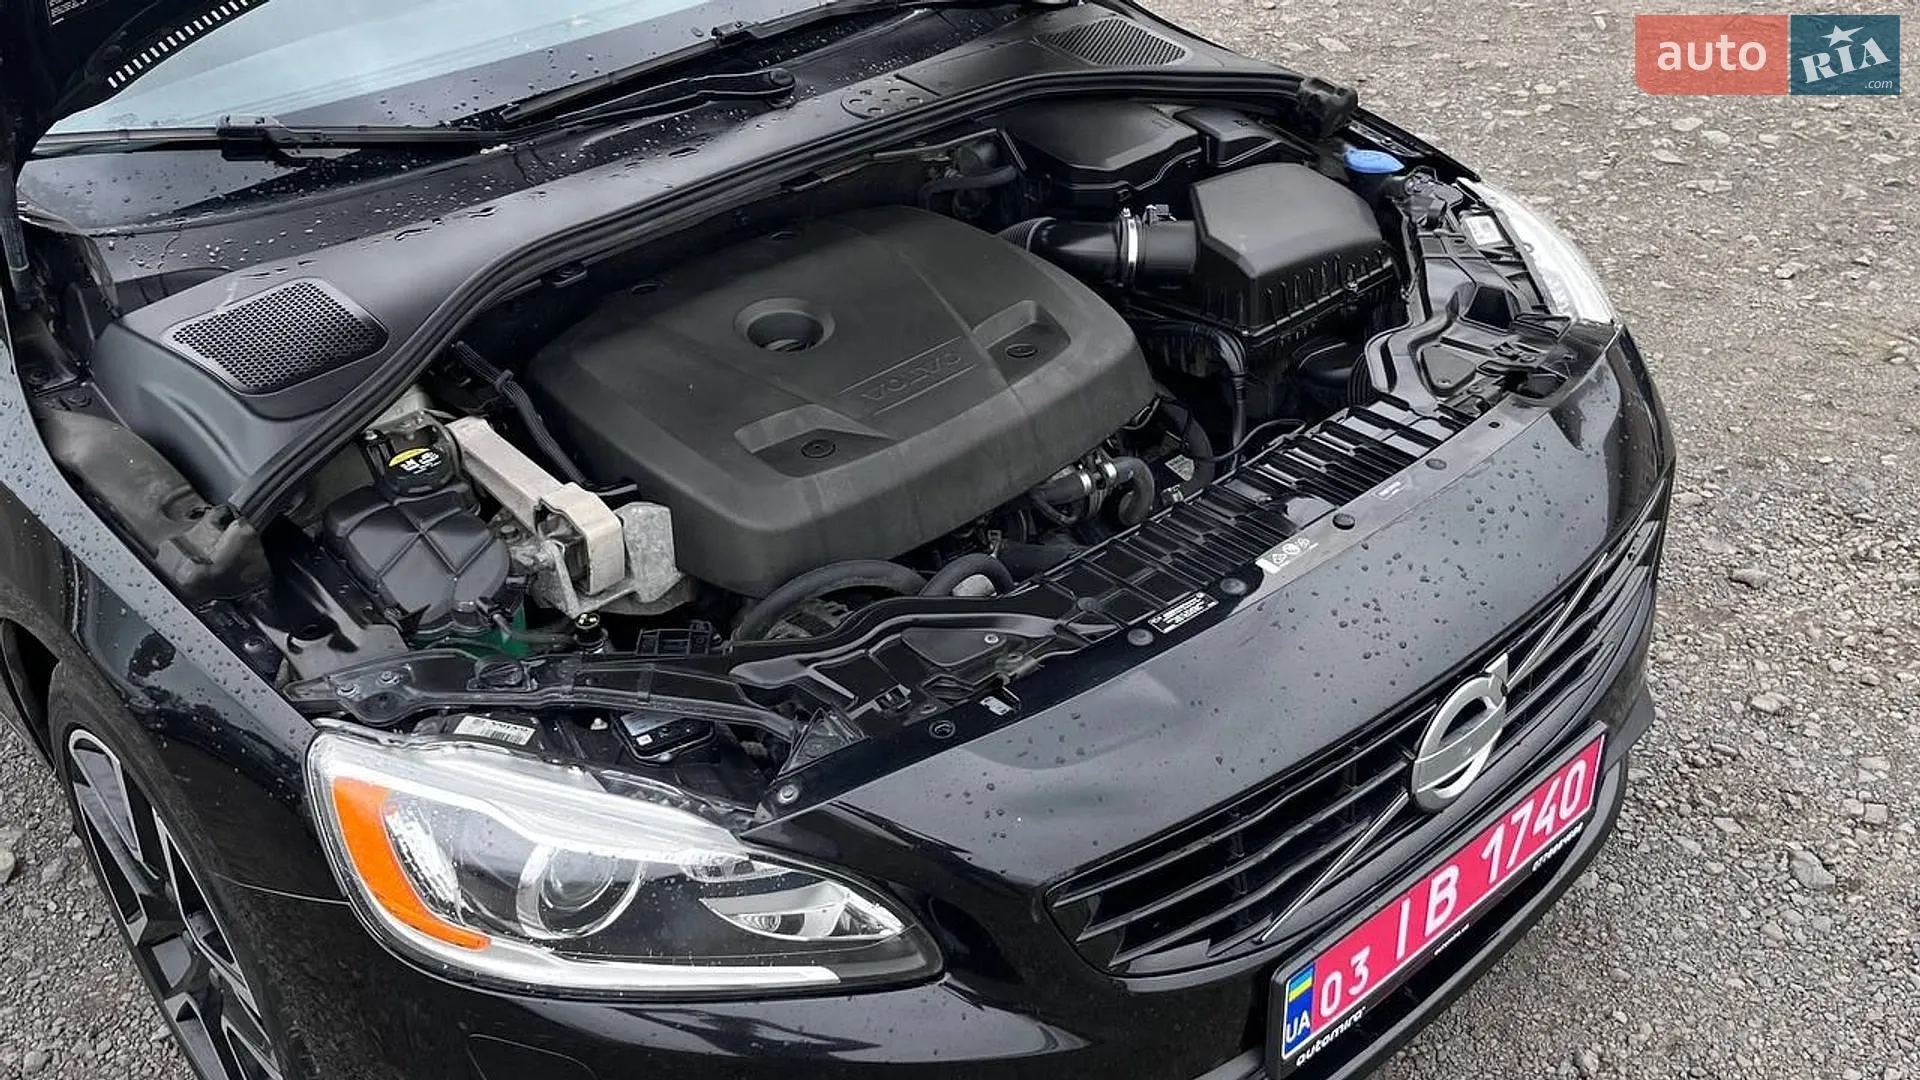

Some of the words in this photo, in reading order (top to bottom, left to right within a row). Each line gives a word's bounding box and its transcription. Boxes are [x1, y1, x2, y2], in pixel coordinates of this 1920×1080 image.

[1320, 945, 1371, 1017] 03
[1396, 865, 1459, 960] IB
[1481, 759, 1587, 884] 1740
[1286, 1010, 1311, 1043] UA
